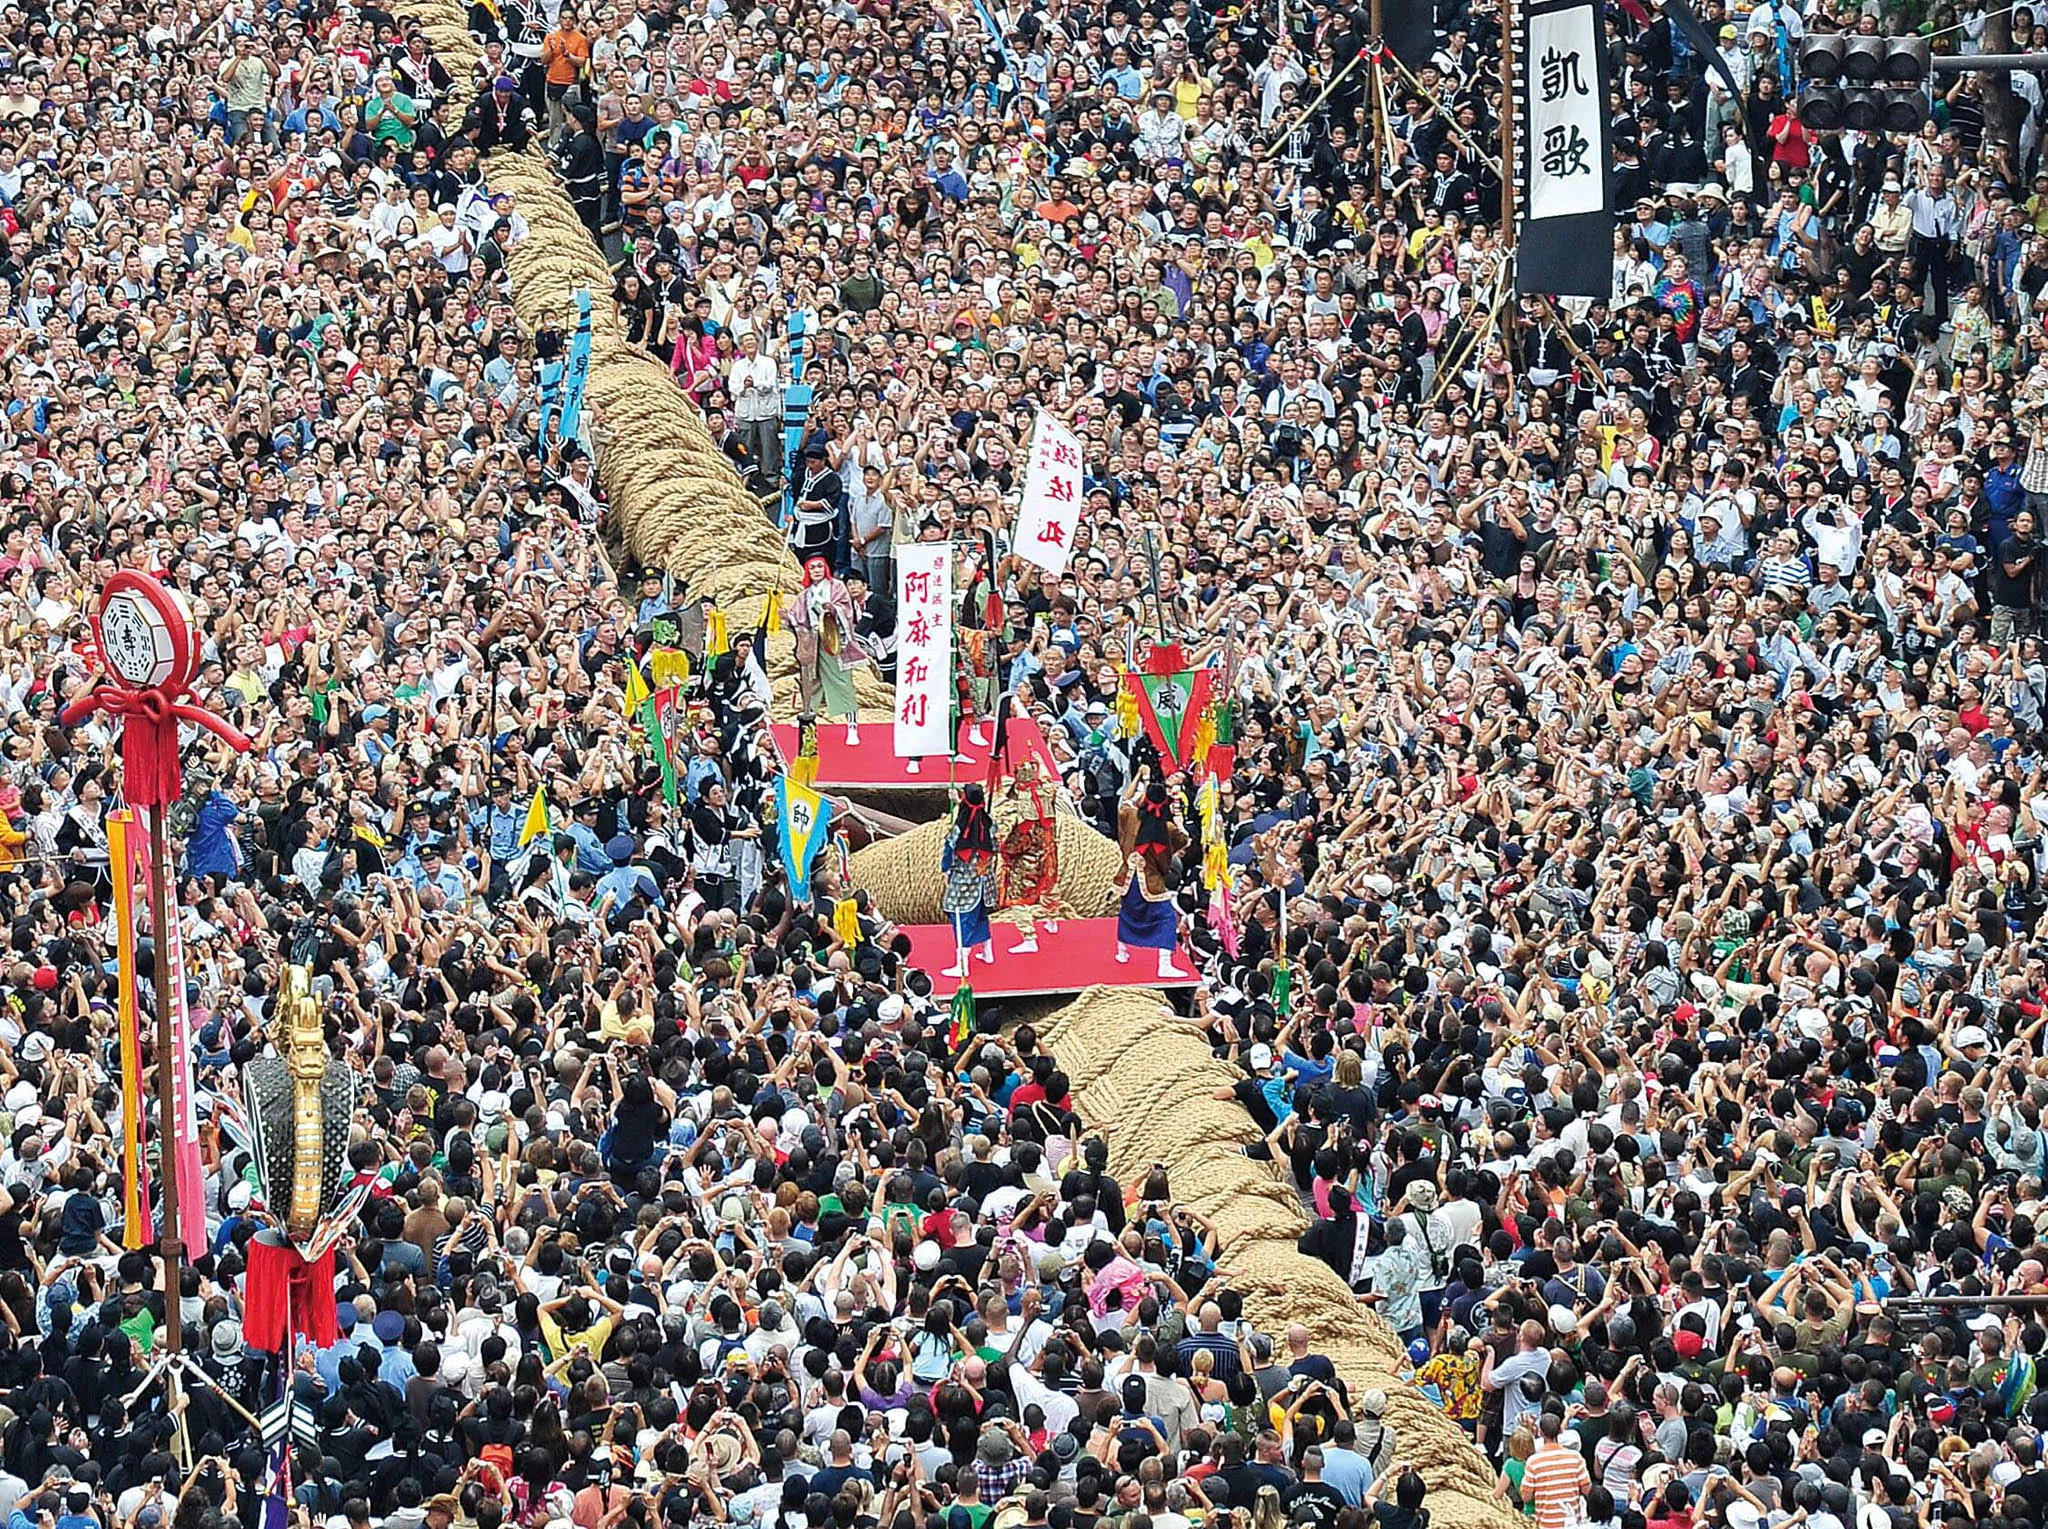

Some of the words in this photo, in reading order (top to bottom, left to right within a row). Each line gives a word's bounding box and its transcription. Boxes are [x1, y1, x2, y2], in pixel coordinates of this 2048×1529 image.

[1541, 46, 1591, 179] 凱歌
[901, 571, 931, 728] 阿麻和利
